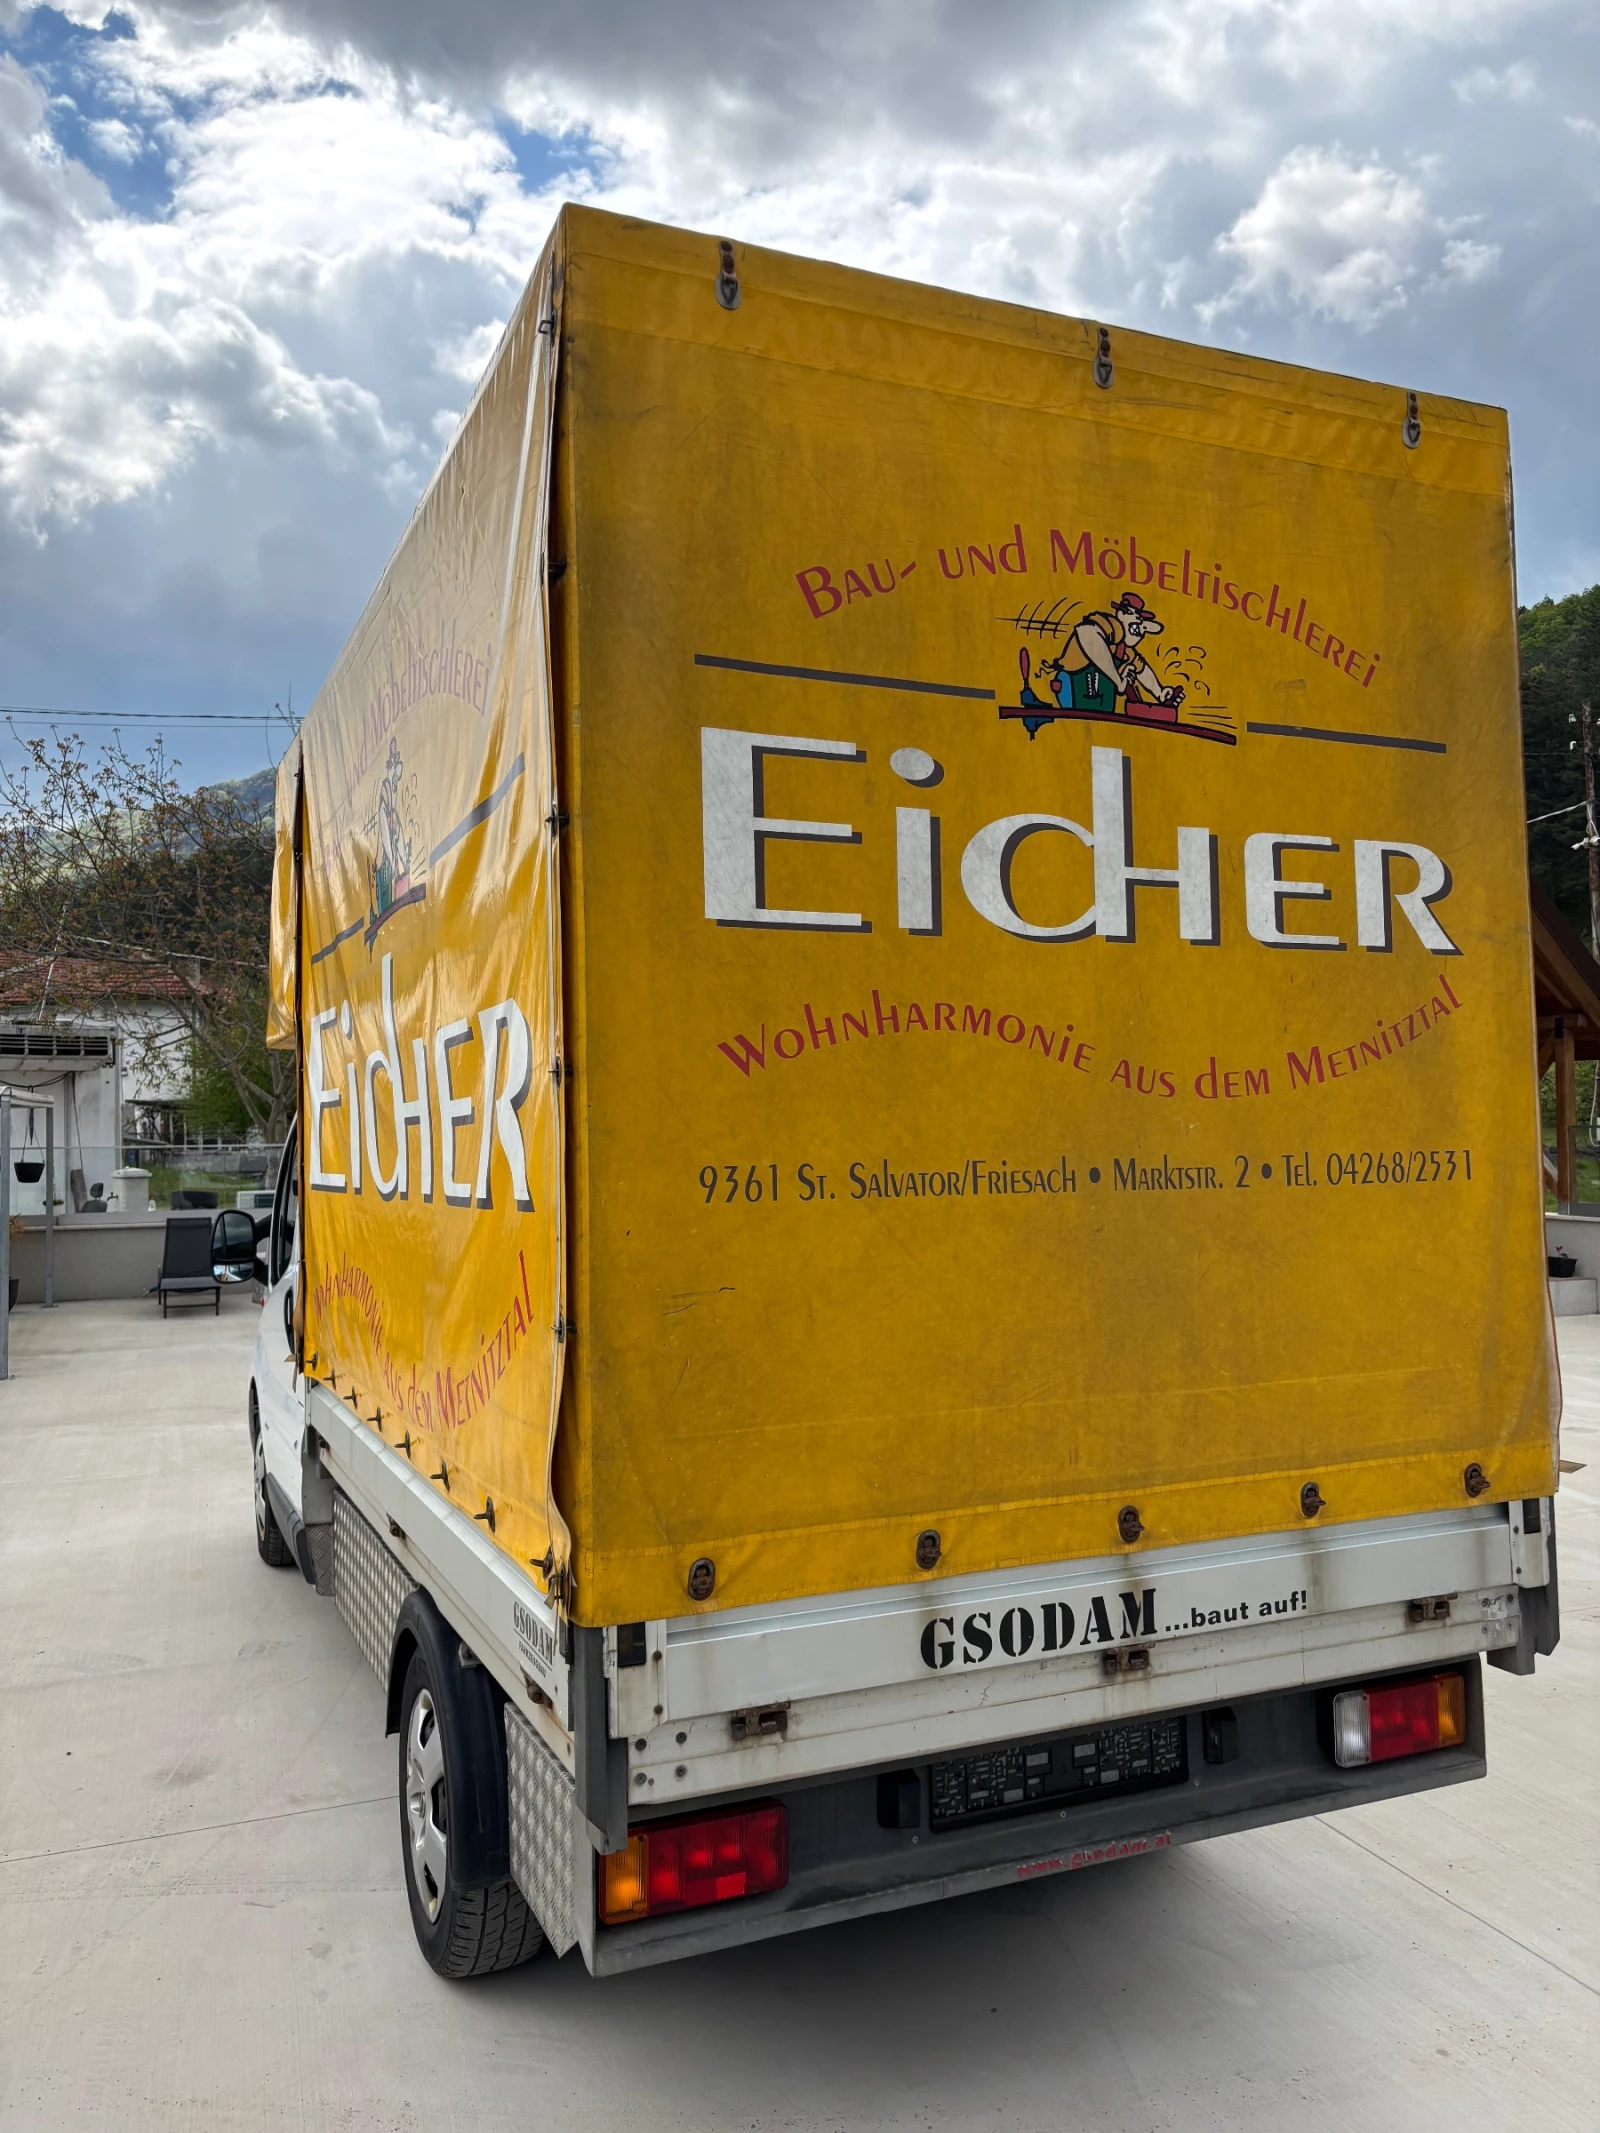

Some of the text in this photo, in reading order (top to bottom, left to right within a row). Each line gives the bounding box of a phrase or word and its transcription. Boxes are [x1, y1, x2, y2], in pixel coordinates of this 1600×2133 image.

[698, 1161, 780, 1204] 9361
[1235, 1155, 1251, 1189] 2
[1325, 1147, 1474, 1187] 04268/2531
[513, 1601, 553, 1666] GSODAM
[920, 1588, 1158, 1670] GSODAM
[1259, 1590, 1308, 1617] auf!
